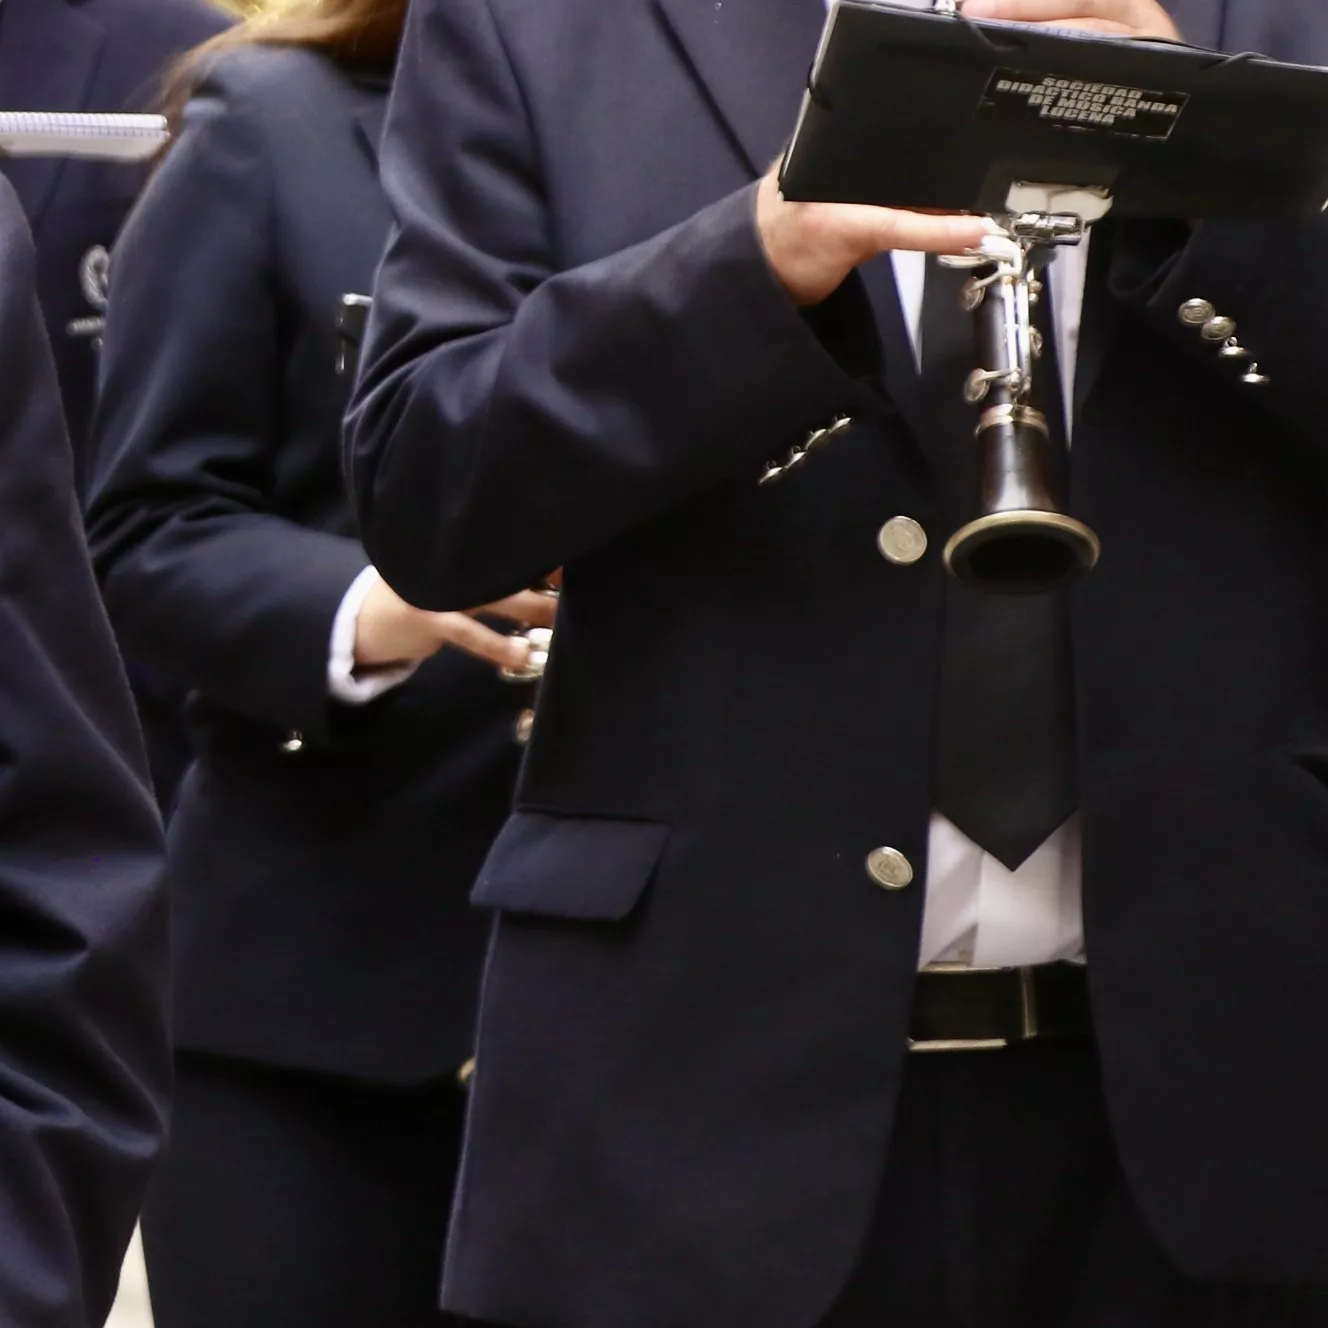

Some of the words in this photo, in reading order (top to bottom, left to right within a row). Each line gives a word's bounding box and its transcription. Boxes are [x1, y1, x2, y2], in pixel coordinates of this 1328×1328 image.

[1042, 77, 1143, 99] SOCIEDAD
[1028, 93, 1055, 106] DE
[1110, 97, 1179, 115] BANDA
[1039, 105, 1116, 125] LUCENA
